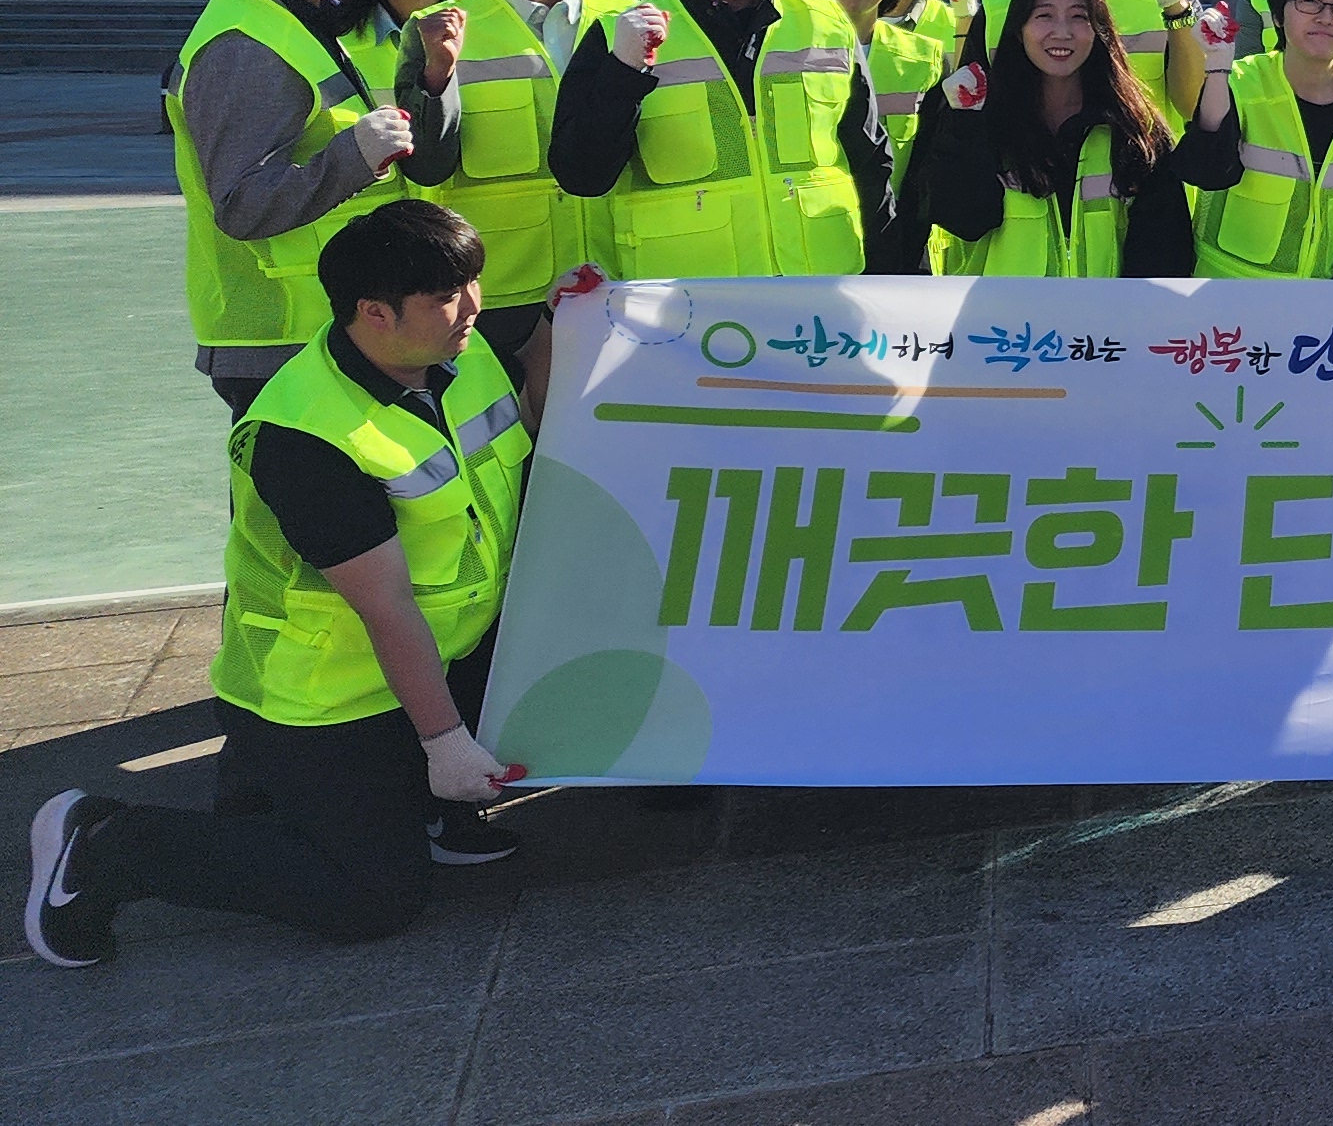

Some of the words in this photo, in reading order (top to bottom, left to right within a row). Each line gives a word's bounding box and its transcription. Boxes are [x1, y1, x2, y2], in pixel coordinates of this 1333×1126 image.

[766, 315, 954, 368] 함께하며
[967, 321, 1128, 372] 혁신하는
[1148, 325, 1282, 375] 행복한
[657, 465, 1194, 632] 깨끗한
